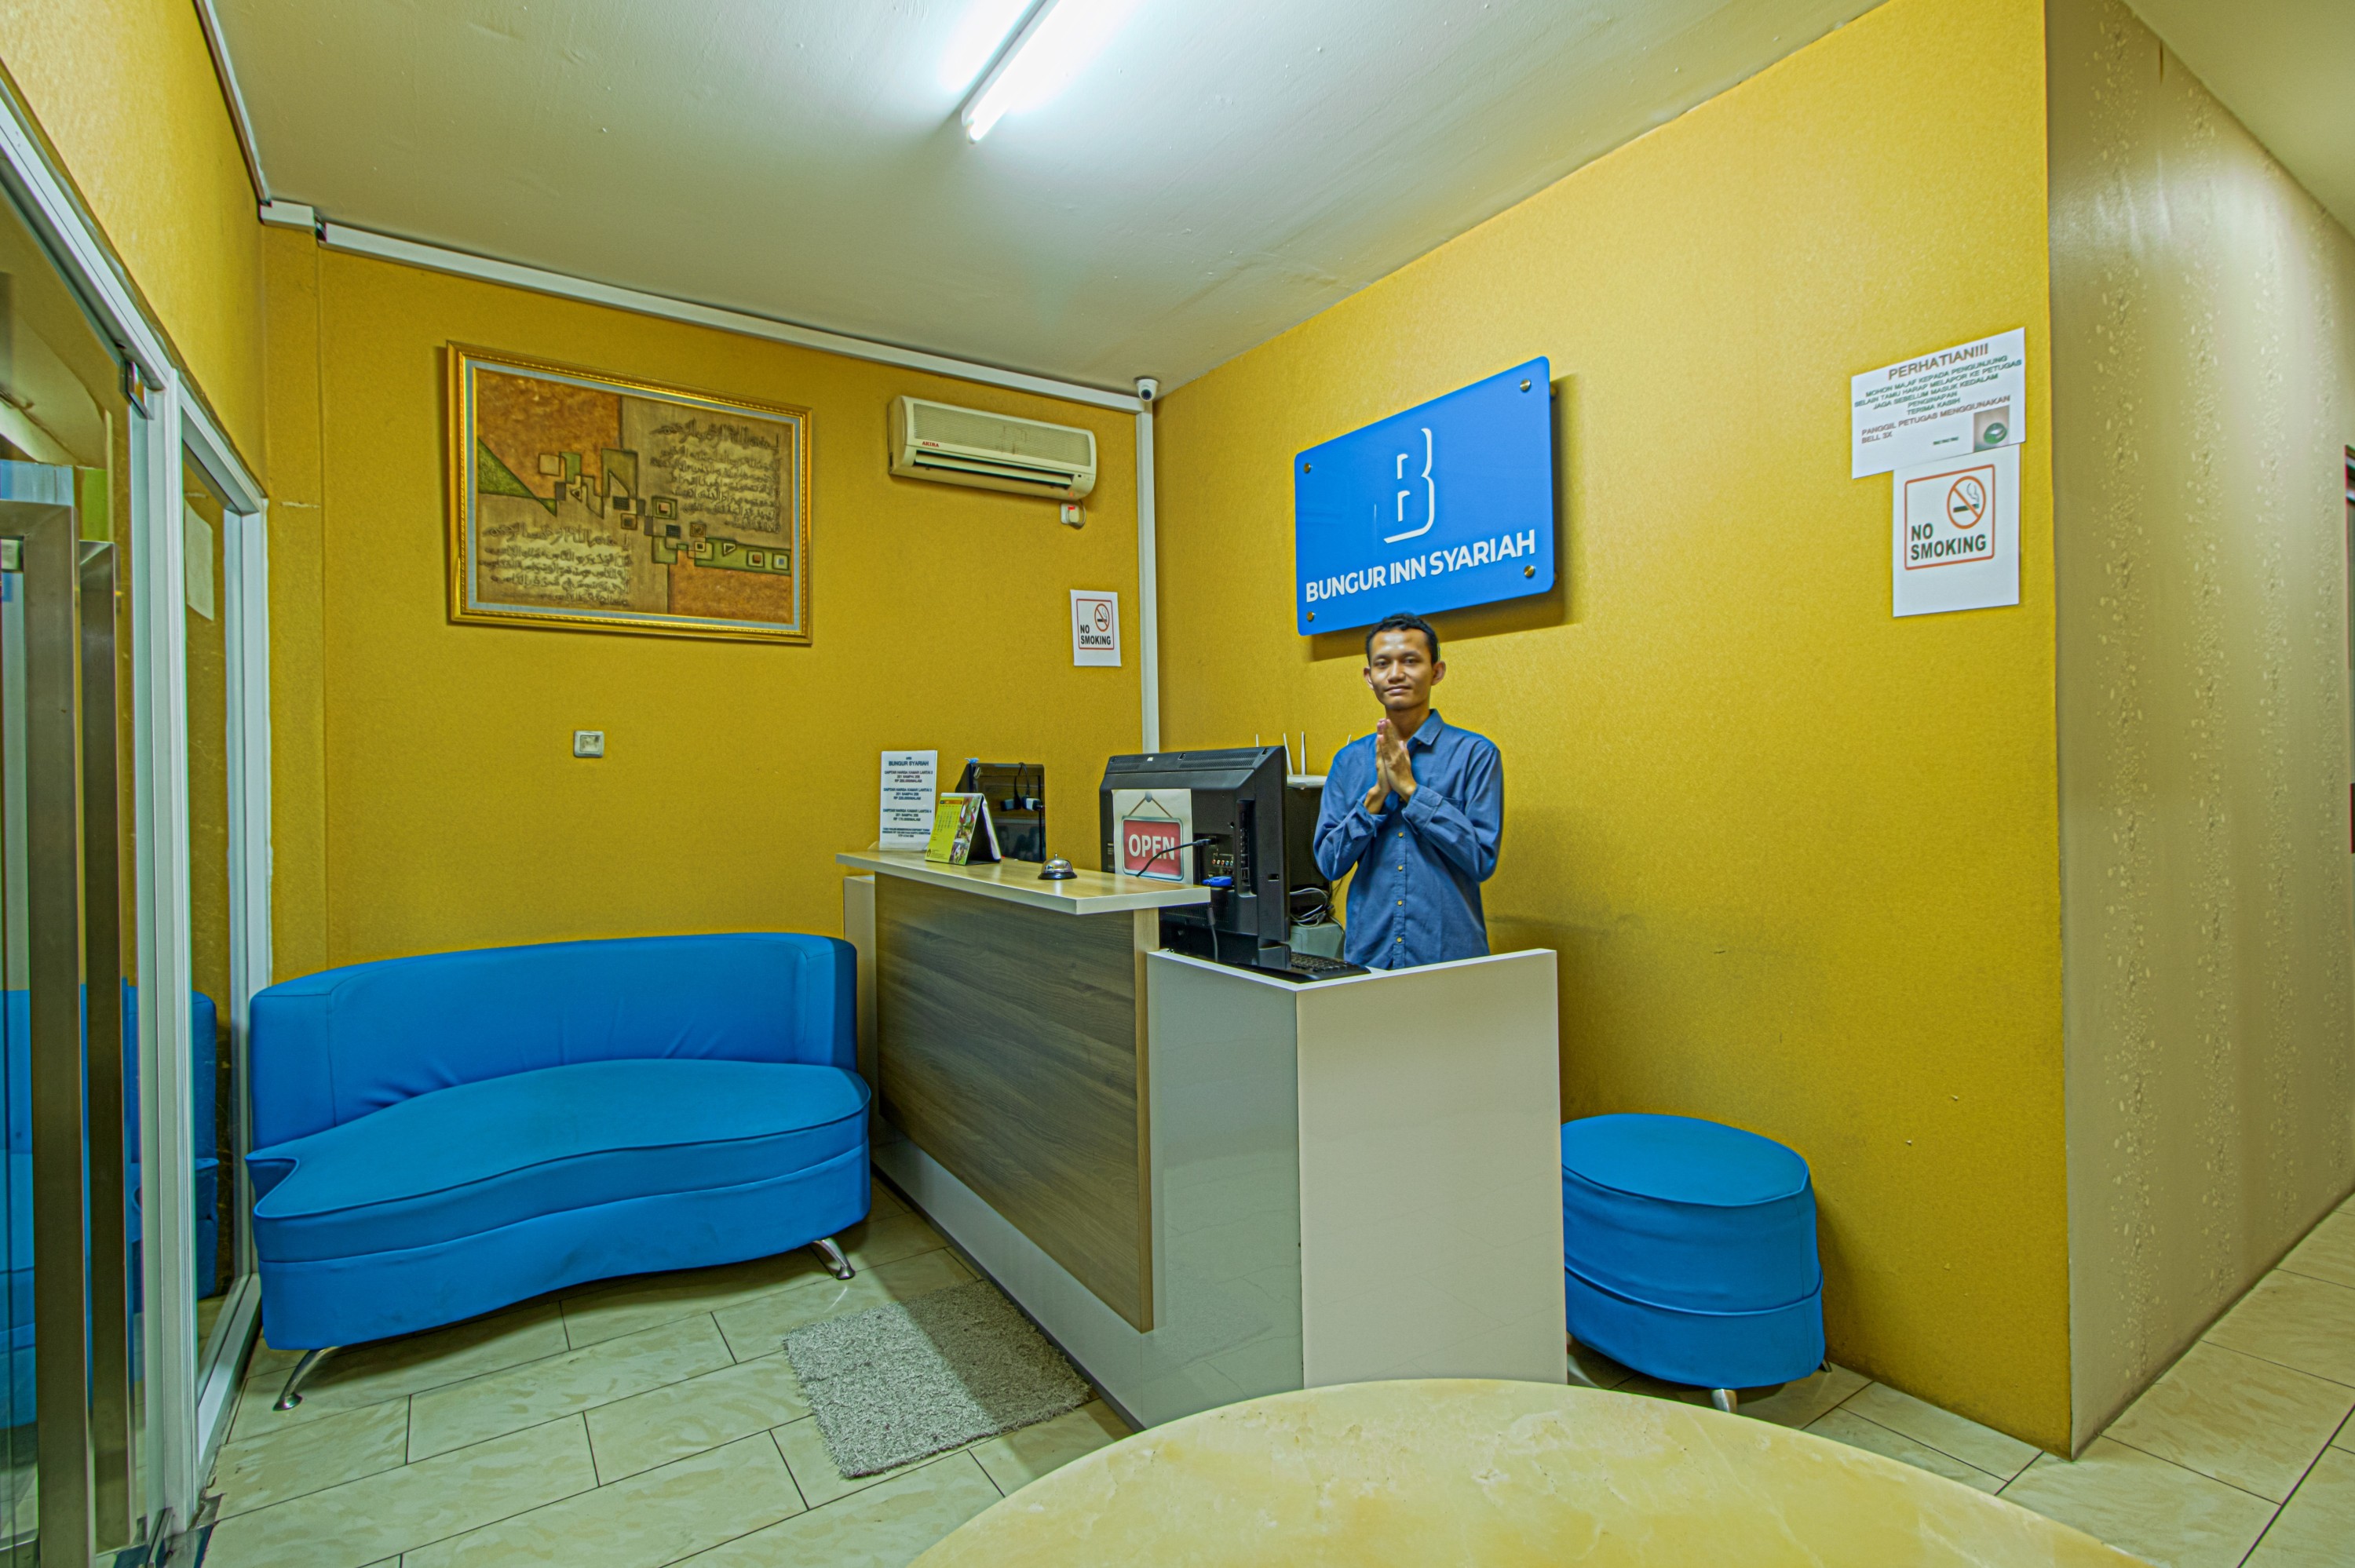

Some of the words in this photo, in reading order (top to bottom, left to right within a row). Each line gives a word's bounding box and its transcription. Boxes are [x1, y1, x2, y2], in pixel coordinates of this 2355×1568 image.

[1854, 397, 1879, 407] SELAIN
[1881, 391, 1900, 400] TAMU
[1902, 384, 1928, 395] HARAP
[1930, 374, 1967, 388] MELAPOR
[1982, 359, 2022, 374] PETUGAS
[1865, 385, 1893, 397] MOHON
[1919, 370, 1949, 384] KEPADA
[1952, 356, 2007, 375] PENGUNJUNG
[1873, 400, 1892, 410] JAGA
[1893, 391, 1929, 404] SEBELUM
[1931, 383, 1958, 395] MASUK
[1959, 374, 1998, 388] KEDALAM
[1908, 391, 1958, 408] PENGINAPAN
[1861, 422, 1896, 436] PANGGIL
[1898, 413, 1938, 427] PETUGAS
[1940, 396, 2010, 418] MENGGUNAKAN
[1907, 404, 1935, 415] TERIMA
[1937, 398, 1960, 408] KASIH
[1861, 434, 1881, 444] BELL
[1882, 431, 1893, 439] 3X
[1911, 523, 1933, 542] NO
[1911, 534, 1987, 560] SMOKING
[1305, 565, 1386, 603] BUNGUR
[1389, 555, 1426, 585] INN
[1429, 529, 1535, 576] SYARIAH
[1079, 624, 1090, 633] NO
[1080, 635, 1112, 645] SMOKING
[1128, 833, 1175, 861] OPEN
